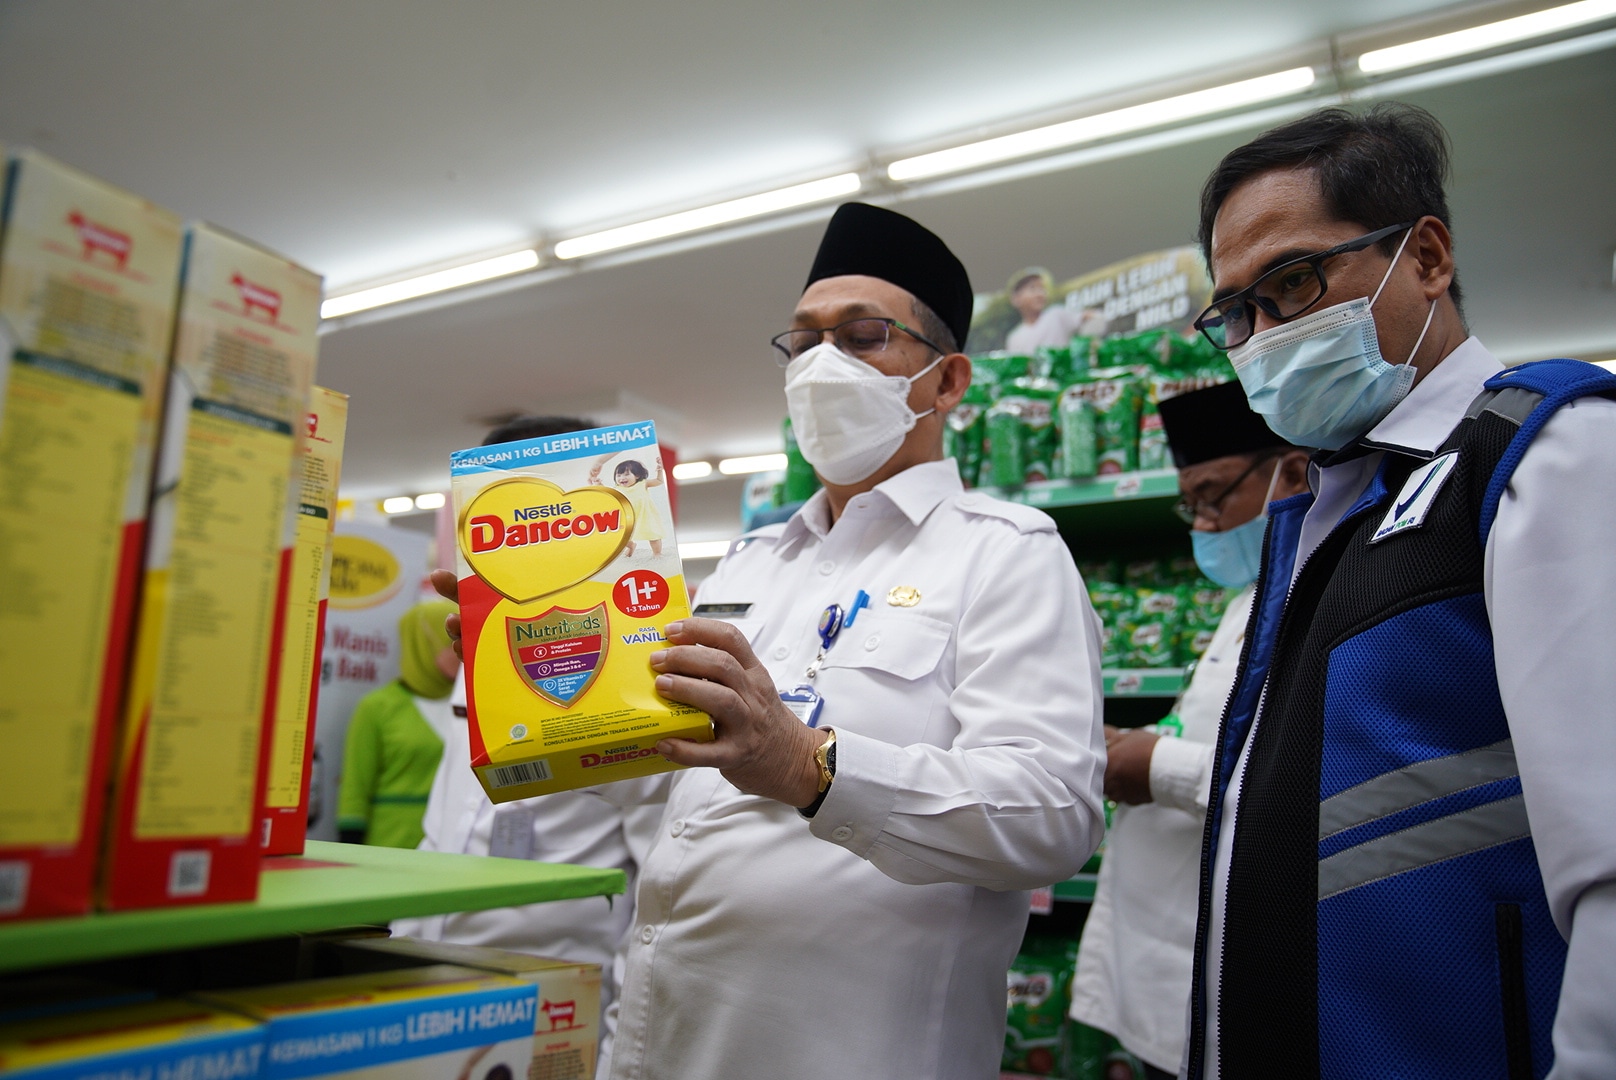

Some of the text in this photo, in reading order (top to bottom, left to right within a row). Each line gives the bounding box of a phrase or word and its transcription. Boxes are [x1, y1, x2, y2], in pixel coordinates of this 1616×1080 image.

[1136, 295, 1190, 330] MILO
[453, 426, 651, 469] KEMASAN 1 KG LEBIH HEMAT
[470, 509, 620, 553] Dancow
[638, 604, 661, 612] Tahun
[622, 632, 668, 644] VANIL
[544, 736, 586, 746] KONSULTASIKAN
[587, 731, 608, 739] DENGAN
[609, 727, 630, 735] TENAGA
[630, 722, 660, 731] KESEHATAN
[580, 746, 660, 768] Danco
[407, 1006, 465, 1042] LEBIH
[469, 997, 536, 1031] HEMAT
